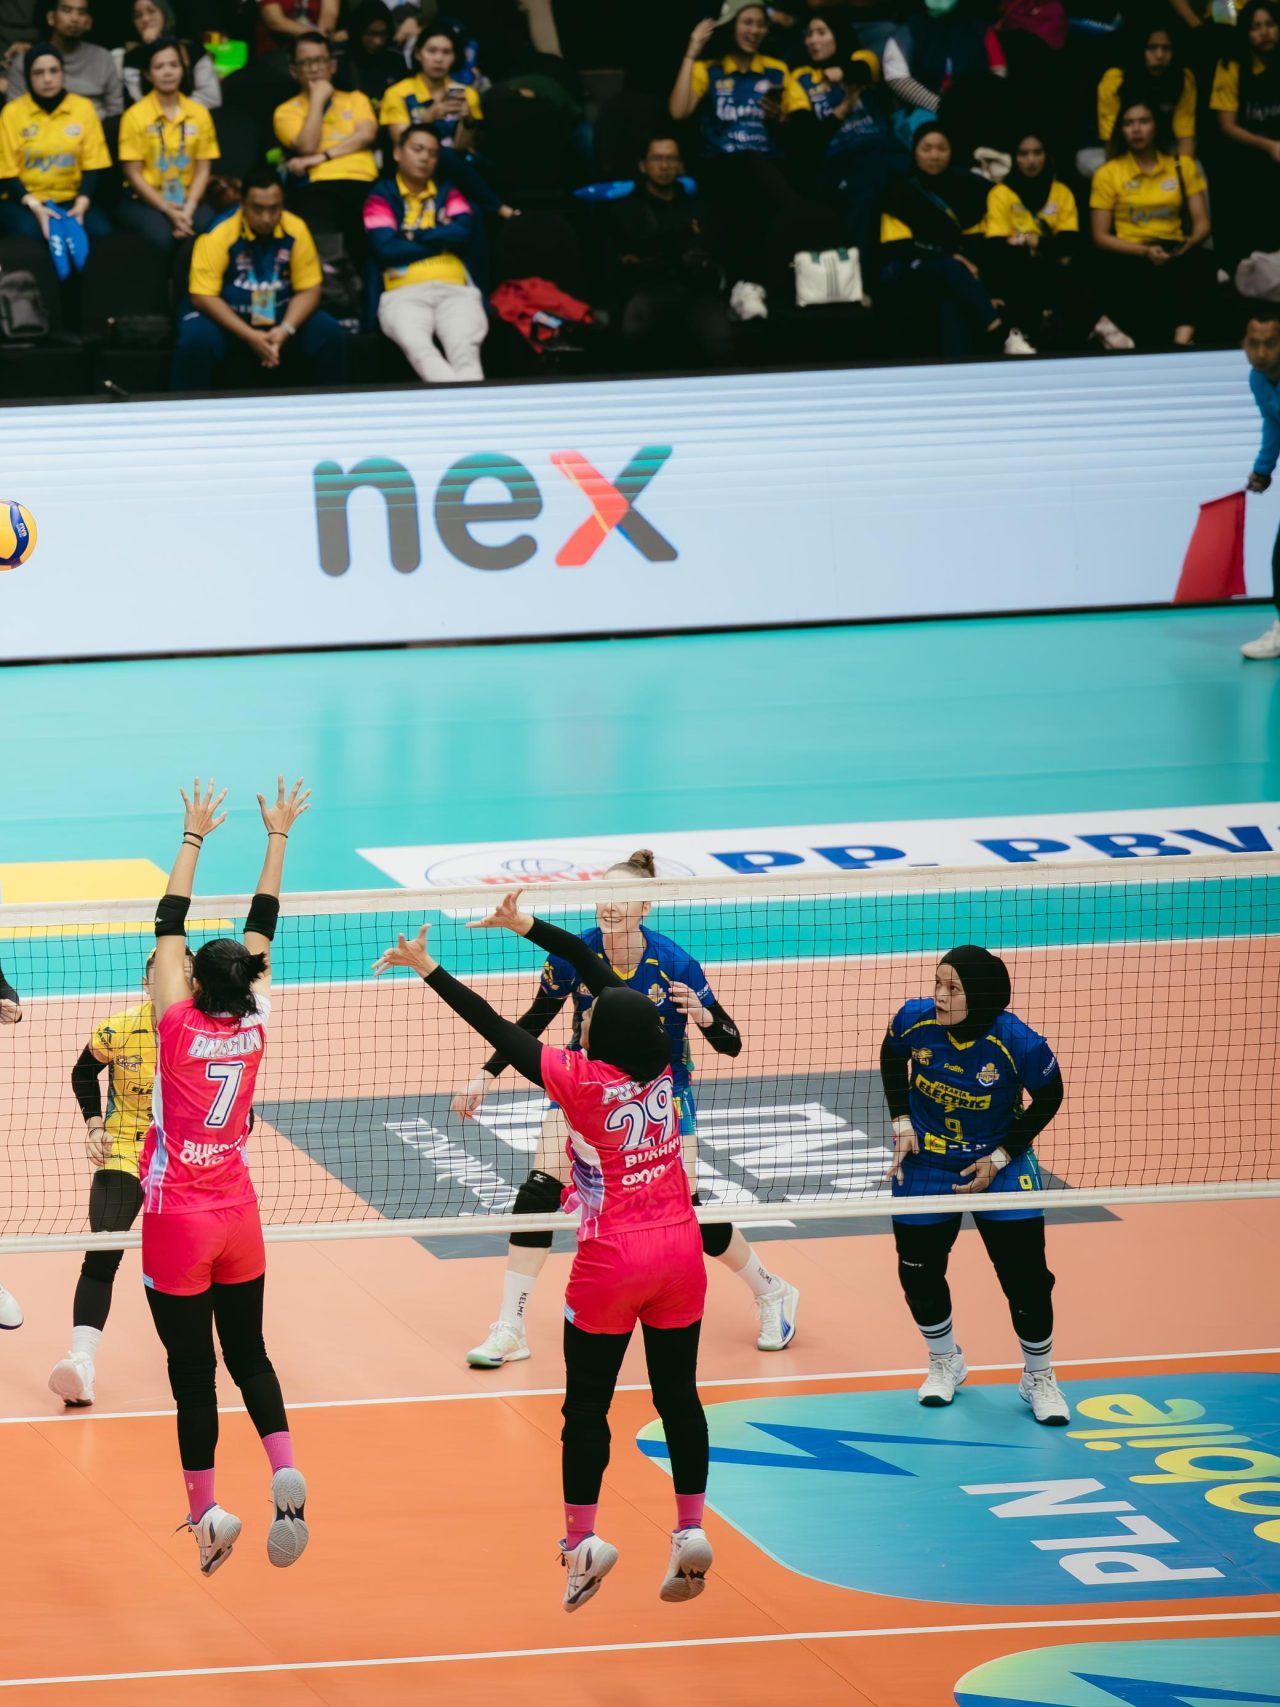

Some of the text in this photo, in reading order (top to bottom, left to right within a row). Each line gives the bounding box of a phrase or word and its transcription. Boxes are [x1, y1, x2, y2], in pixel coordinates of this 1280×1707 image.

[313, 444, 679, 577] nex
[707, 825, 1280, 874] PP PBV
[205, 1060, 246, 1129] 7
[605, 1075, 674, 1152] 29
[944, 1118, 964, 1141] 9
[516, 1291, 529, 1319] KELME
[1066, 1393, 1280, 1544] obile
[959, 1477, 1227, 1586] PLN
